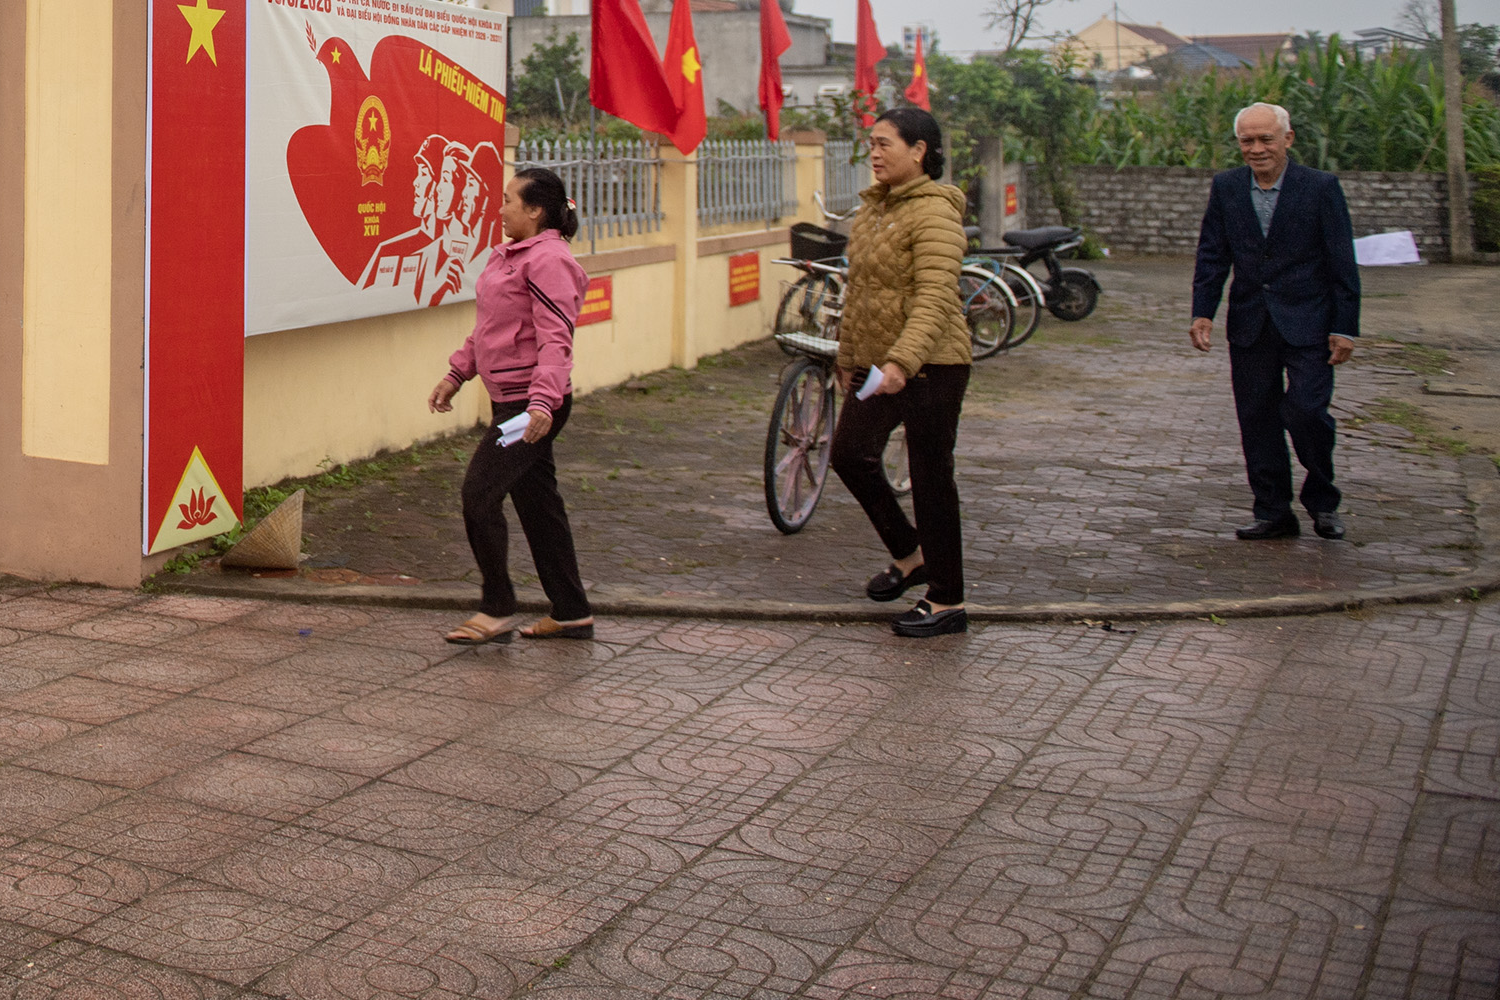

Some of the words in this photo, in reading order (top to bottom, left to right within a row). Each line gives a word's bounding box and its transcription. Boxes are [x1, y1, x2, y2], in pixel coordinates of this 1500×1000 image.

[419, 48, 432, 77] LÁ
[490, 96, 504, 124] TIN
[364, 225, 379, 236] XVI
